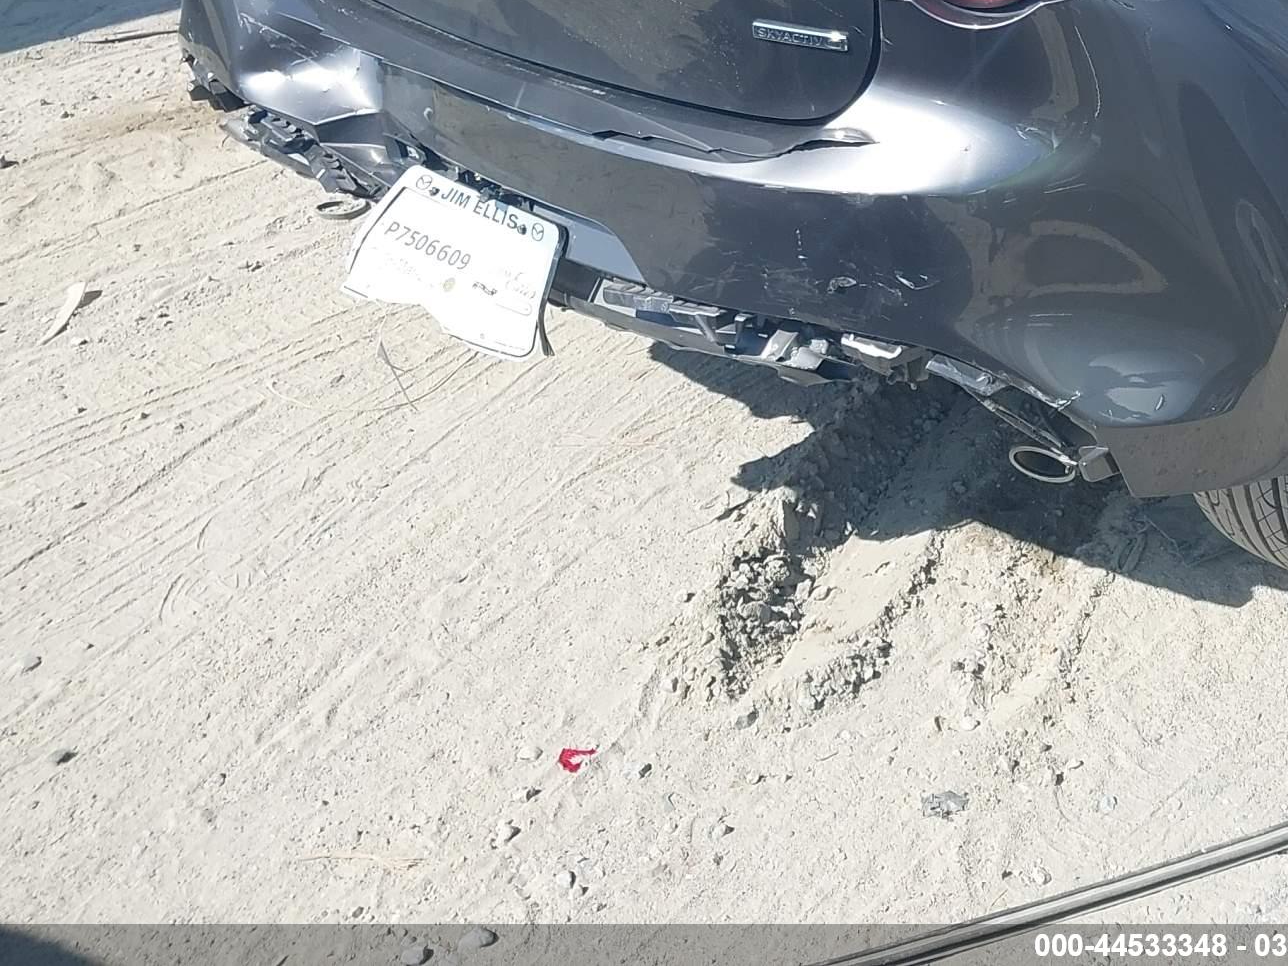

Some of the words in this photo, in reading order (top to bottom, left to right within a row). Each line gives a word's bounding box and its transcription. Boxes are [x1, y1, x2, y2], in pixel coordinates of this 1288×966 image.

[441, 187, 471, 209] JIM
[473, 194, 518, 229] ELLIS
[384, 221, 471, 270] P7506609
